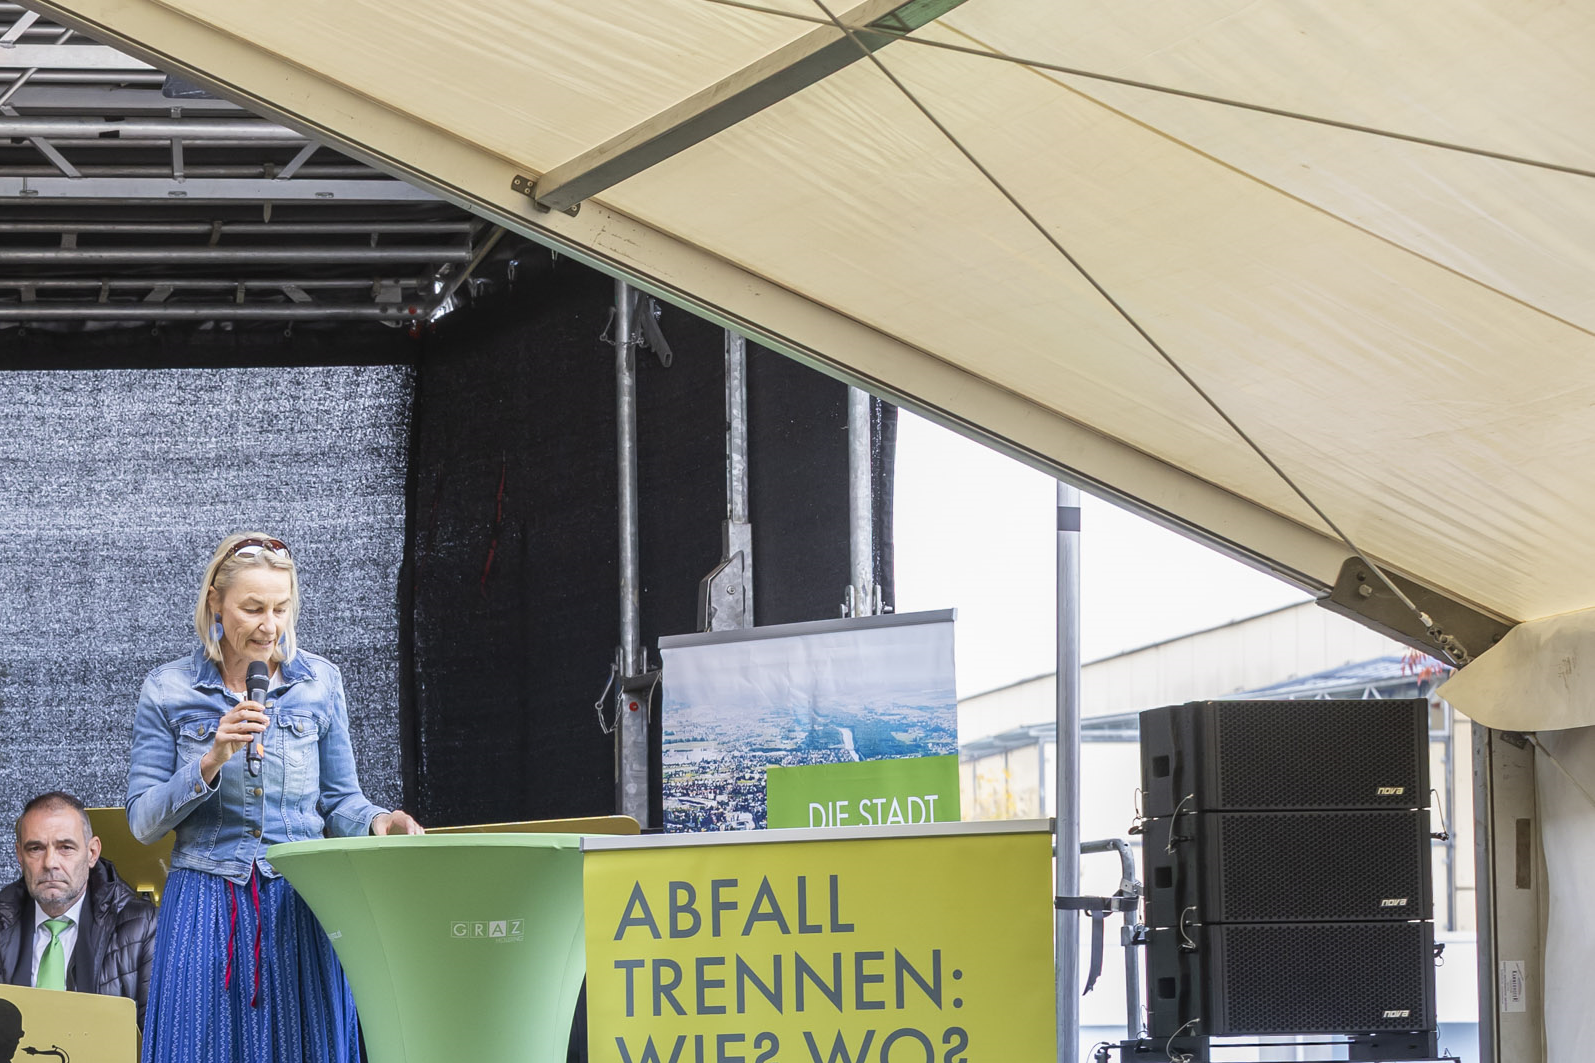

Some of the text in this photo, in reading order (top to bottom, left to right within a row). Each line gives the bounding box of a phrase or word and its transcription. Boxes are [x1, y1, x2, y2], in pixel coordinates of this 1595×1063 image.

[1377, 787, 1404, 795] nova
[809, 795, 939, 829] DIE STADT
[614, 874, 856, 942] ABFALL
[1381, 898, 1408, 907] nova
[451, 919, 525, 938] GRAZ
[614, 948, 965, 1018] TRENNEN:
[1383, 1010, 1410, 1018] nova
